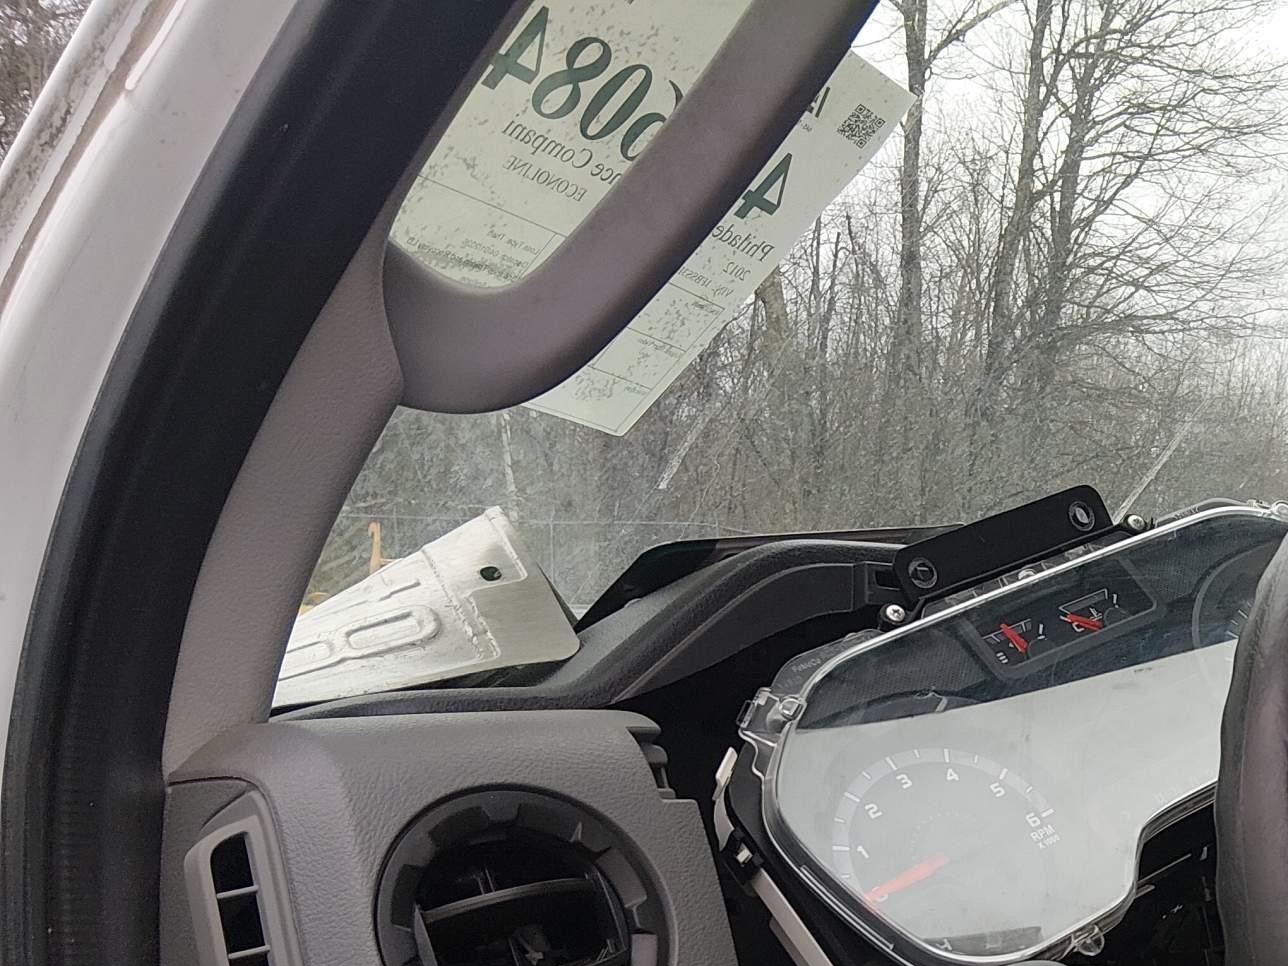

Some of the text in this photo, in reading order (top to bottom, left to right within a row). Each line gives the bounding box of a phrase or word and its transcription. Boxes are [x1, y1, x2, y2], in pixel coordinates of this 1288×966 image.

[896, 773, 913, 789] 3
[945, 768, 960, 782] 4
[989, 782, 1006, 797] 5
[864, 803, 883, 819] 2
[1025, 812, 1041, 828] 6
[1030, 824, 1056, 842] RPM
[857, 845, 870, 859] 1
